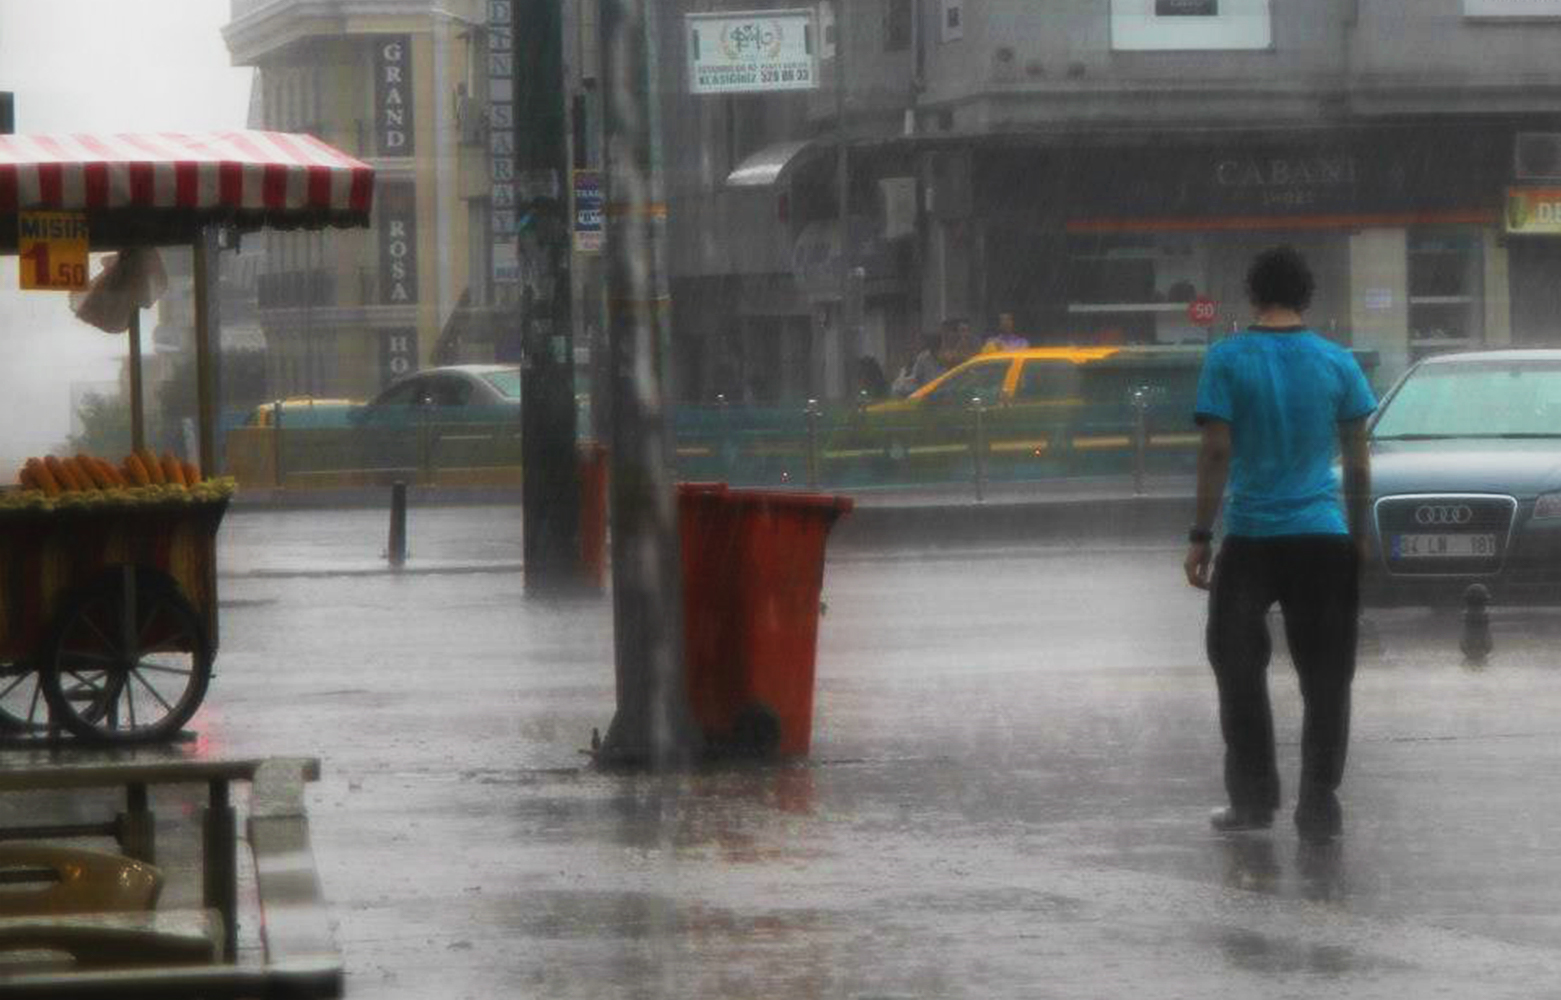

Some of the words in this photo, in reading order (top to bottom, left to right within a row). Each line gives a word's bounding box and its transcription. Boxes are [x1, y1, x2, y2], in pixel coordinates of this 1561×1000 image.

[383, 43, 405, 147] GRAND
[389, 220, 408, 301] ROSA
[1195, 302, 1215, 320] 50
